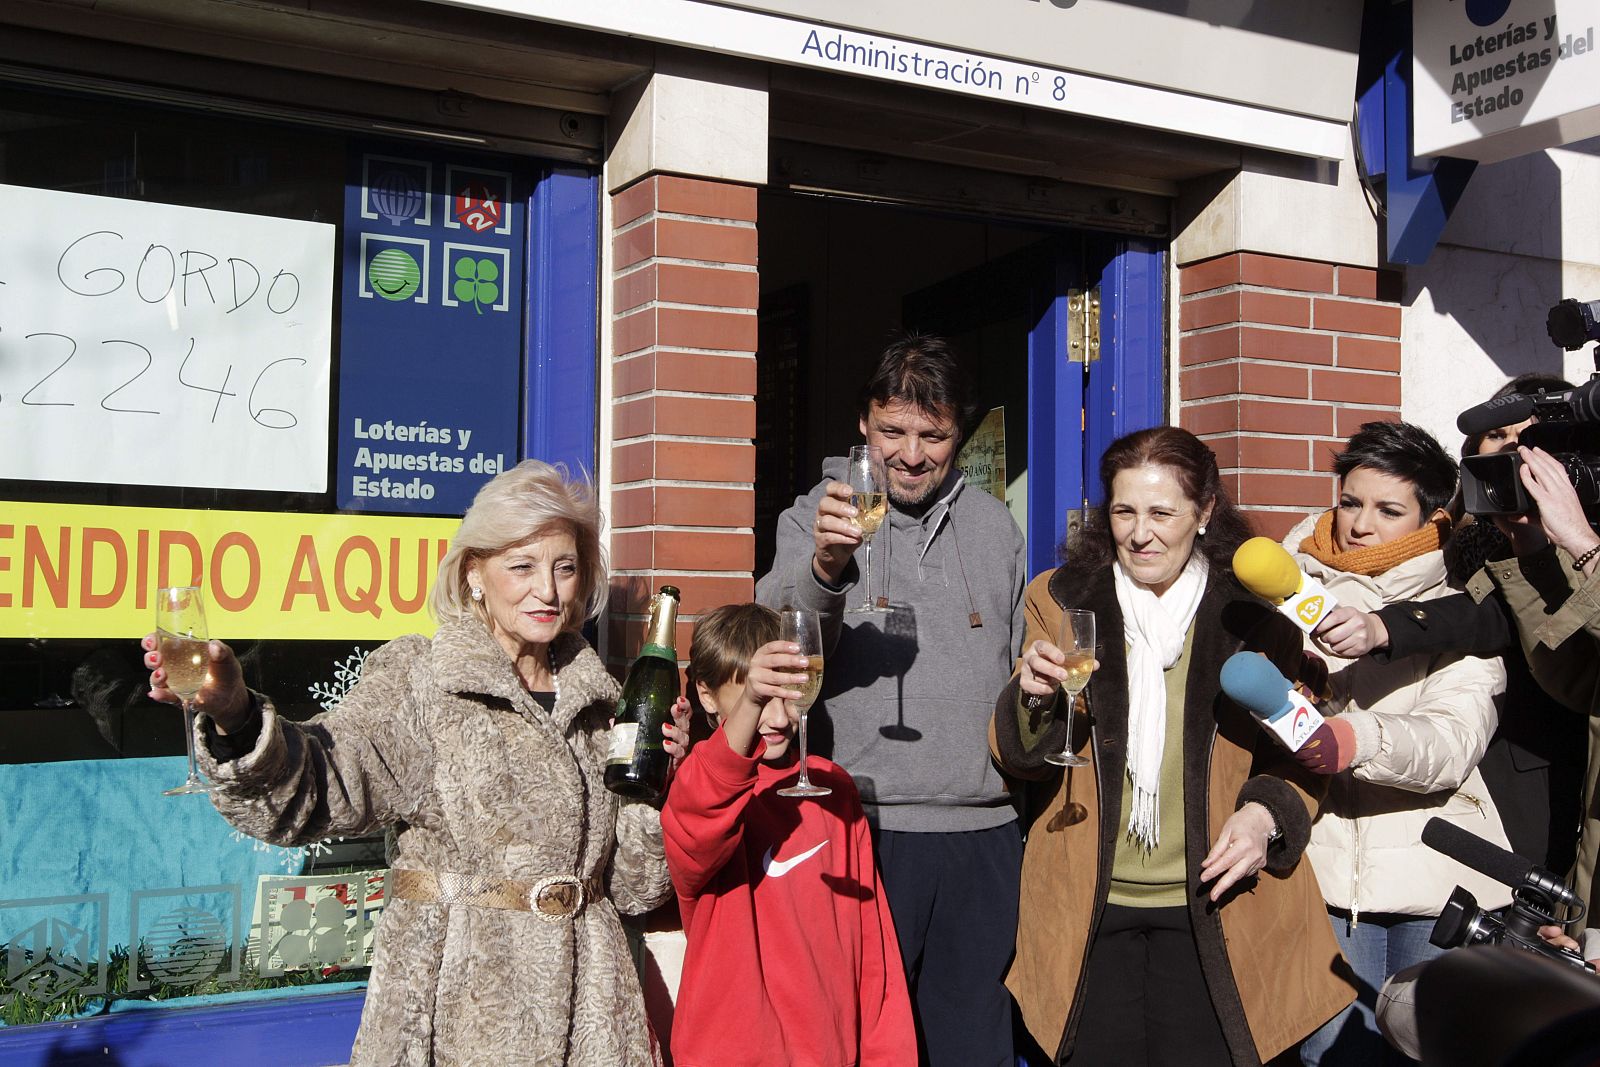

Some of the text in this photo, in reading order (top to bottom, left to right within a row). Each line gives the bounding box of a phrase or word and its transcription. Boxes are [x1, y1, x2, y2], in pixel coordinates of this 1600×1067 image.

[1450, 14, 1557, 66] Loterías y
[1451, 27, 1594, 96] Apuestas del
[801, 29, 1002, 90] Administración
[1052, 75, 1067, 102] 8
[1451, 85, 1525, 124] Estado
[57, 230, 300, 315] GORDO
[354, 417, 472, 451] Loterías y
[353, 447, 504, 475] Apuestas del
[352, 475, 435, 500] Estado
